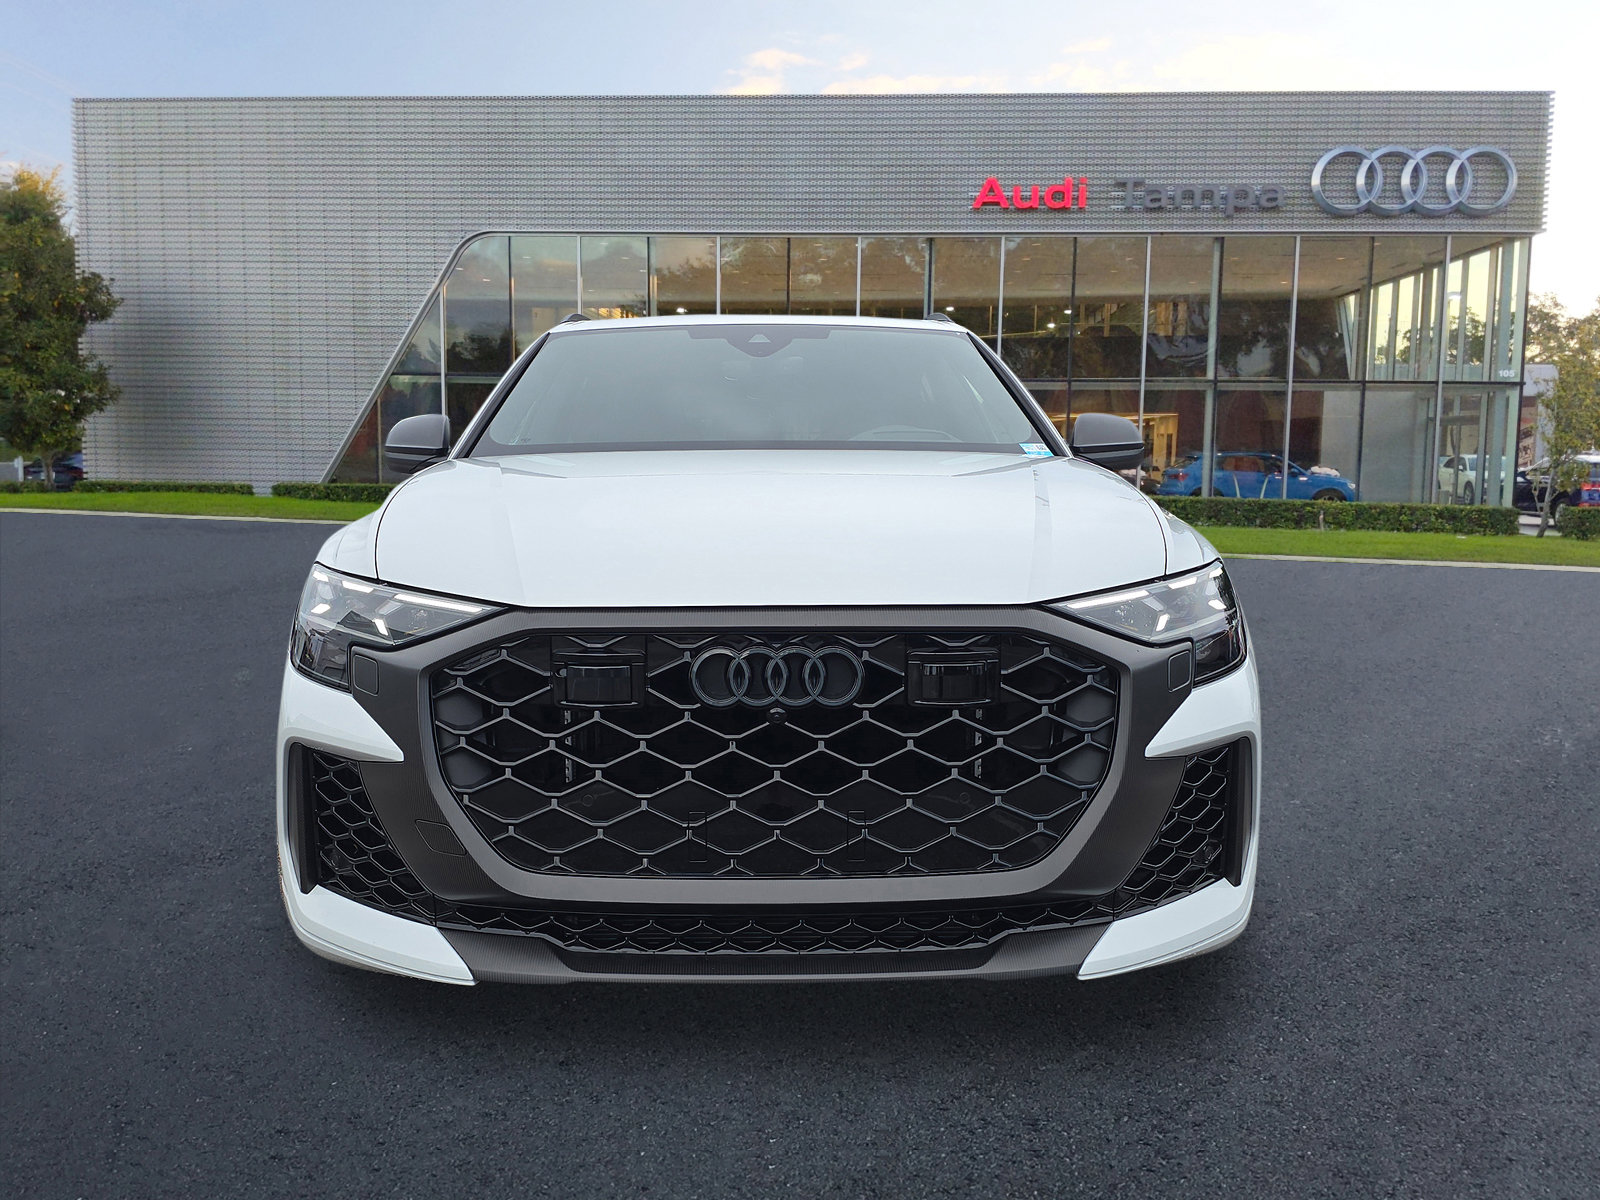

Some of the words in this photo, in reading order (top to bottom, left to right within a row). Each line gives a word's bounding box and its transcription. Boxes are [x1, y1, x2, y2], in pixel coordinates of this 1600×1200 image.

[973, 177, 1088, 210] Audi
[1115, 178, 1285, 217] Tampa
[1499, 369, 1515, 378] 105
